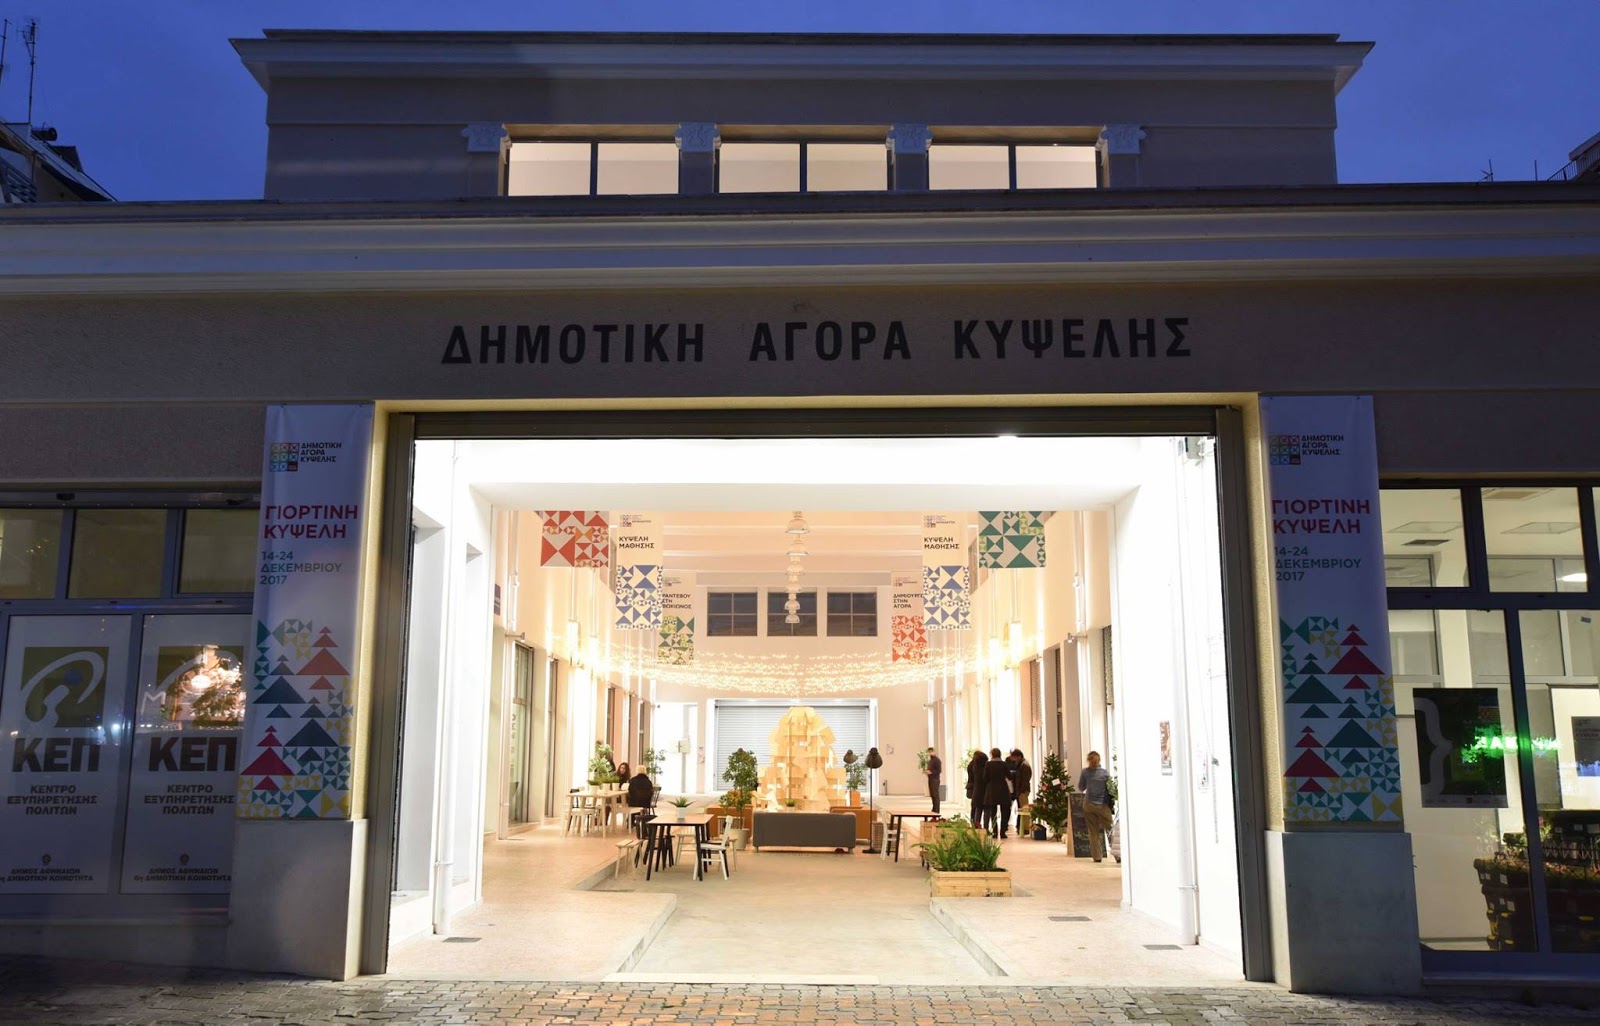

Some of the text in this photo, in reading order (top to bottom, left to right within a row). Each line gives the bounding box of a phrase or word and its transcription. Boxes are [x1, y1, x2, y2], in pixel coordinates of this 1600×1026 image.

[441, 317, 1192, 364] ΔΗΜΟΤΙΚΗ ΑΓΟΡΑ ΚΥΨΕΛΗΣ
[1301, 434, 1344, 442] ΔΗΜΟΤΙΚΗ
[301, 441, 342, 449] ΔΗΜΟΤΙΚΗ
[1302, 448, 1340, 456] ΚΥΨΕΛΗΣ
[300, 455, 336, 463] ΚΥΨΕΛΗΣ
[1272, 499, 1370, 514] ΓΙΟΡΤΙΝΗ
[265, 504, 358, 520] ΓΙΟΡΤΙΝΗ
[264, 524, 346, 539] ΚΥΨΕΛΗ
[1273, 519, 1361, 534] ΚΥΨΕΛΗ
[262, 551, 294, 561] 14-24
[1274, 547, 1308, 556] 14-24
[260, 563, 342, 573] ΔΕΚΕΜΒΡΙΟΥ
[1275, 559, 1361, 569] ΔΕΚΕΜΒΡΙΟΥ
[259, 575, 287, 585] 2017
[1276, 571, 1305, 581] 2017
[12, 737, 99, 772] ΚΕΠ
[148, 736, 237, 772] ΚΕΠ
[30, 785, 76, 794] ΚΕΝΤΡΟ
[167, 784, 213, 793] ΚΕΝΤΡΟ
[7, 796, 98, 804] ΕΞΥΠΗΡΕΤΗΣΗΣ
[144, 795, 235, 804] ΕΞΥΠΗΡΕΤΗΣΗΣ
[26, 806, 77, 815] ΠΟΛΙΤΩΝ
[163, 806, 214, 815] ΠΟΛΙΤΩΝ
